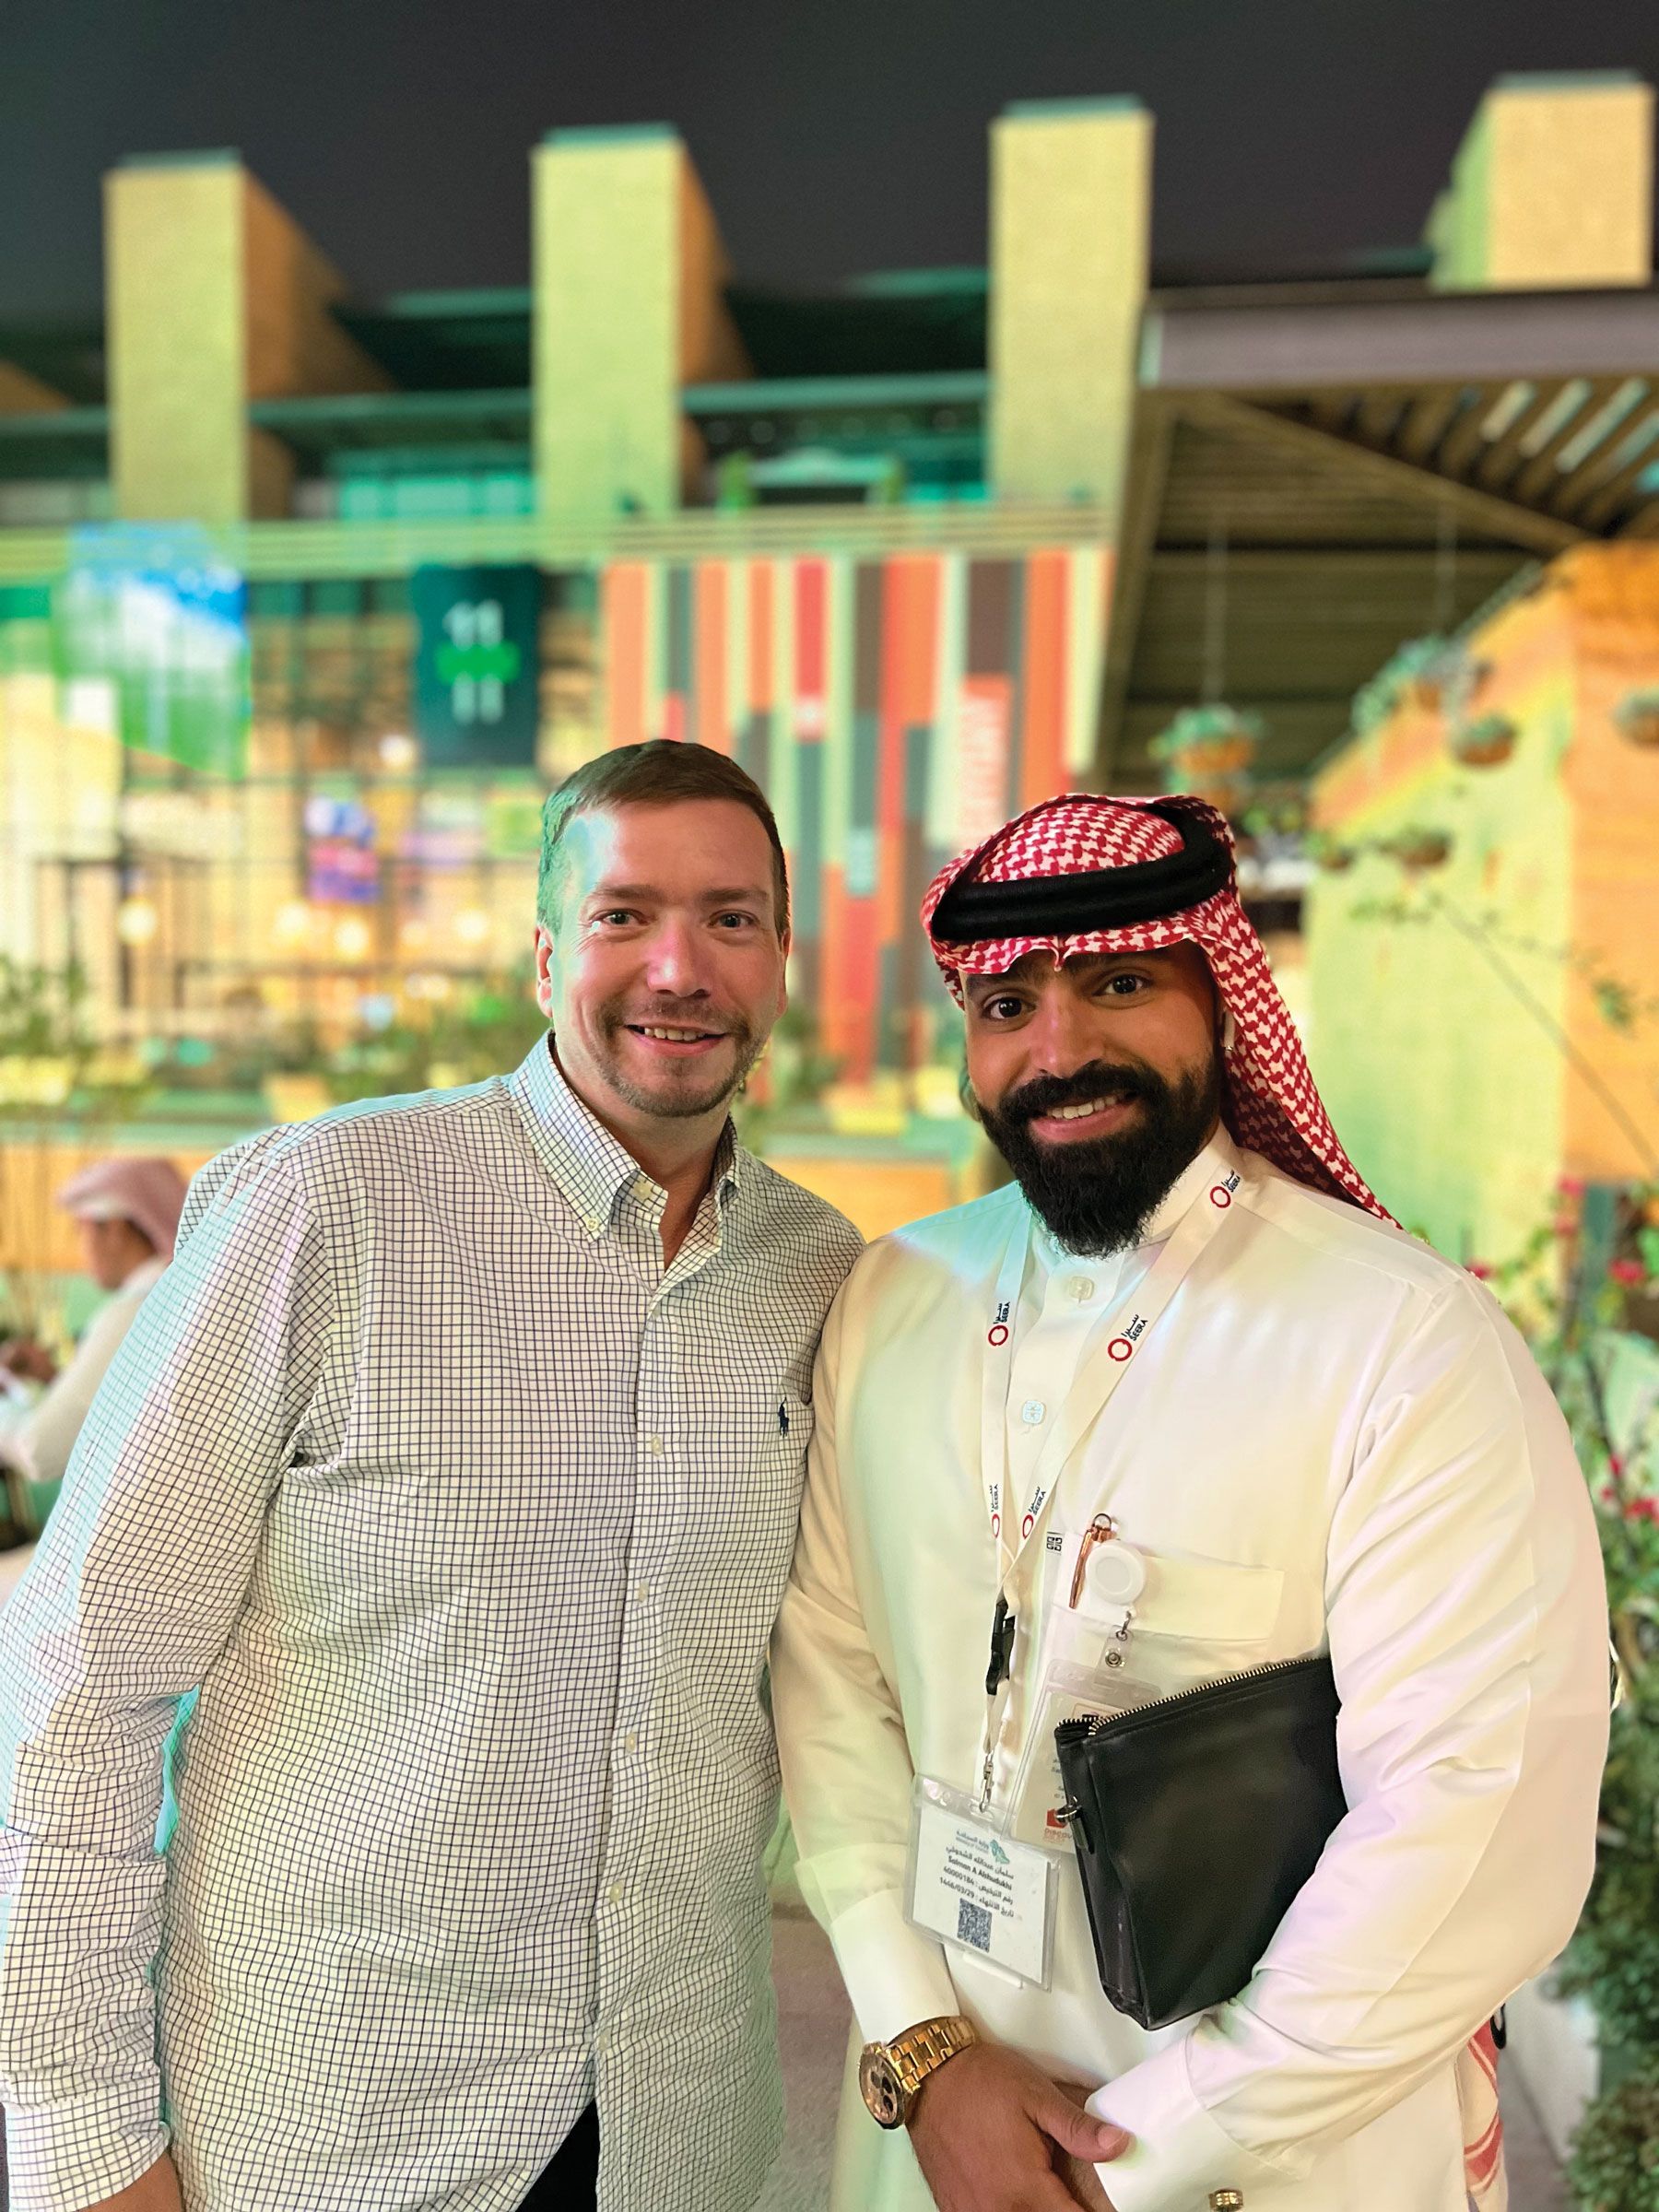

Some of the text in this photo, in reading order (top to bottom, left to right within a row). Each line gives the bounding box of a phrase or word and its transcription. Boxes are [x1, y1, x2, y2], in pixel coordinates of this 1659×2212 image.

[1000, 1301, 1010, 1323] SEERA
[1131, 1320, 1148, 1341] SEERA
[1033, 1491, 1046, 1515] SEERA
[948, 1855, 971, 1872] Salman
